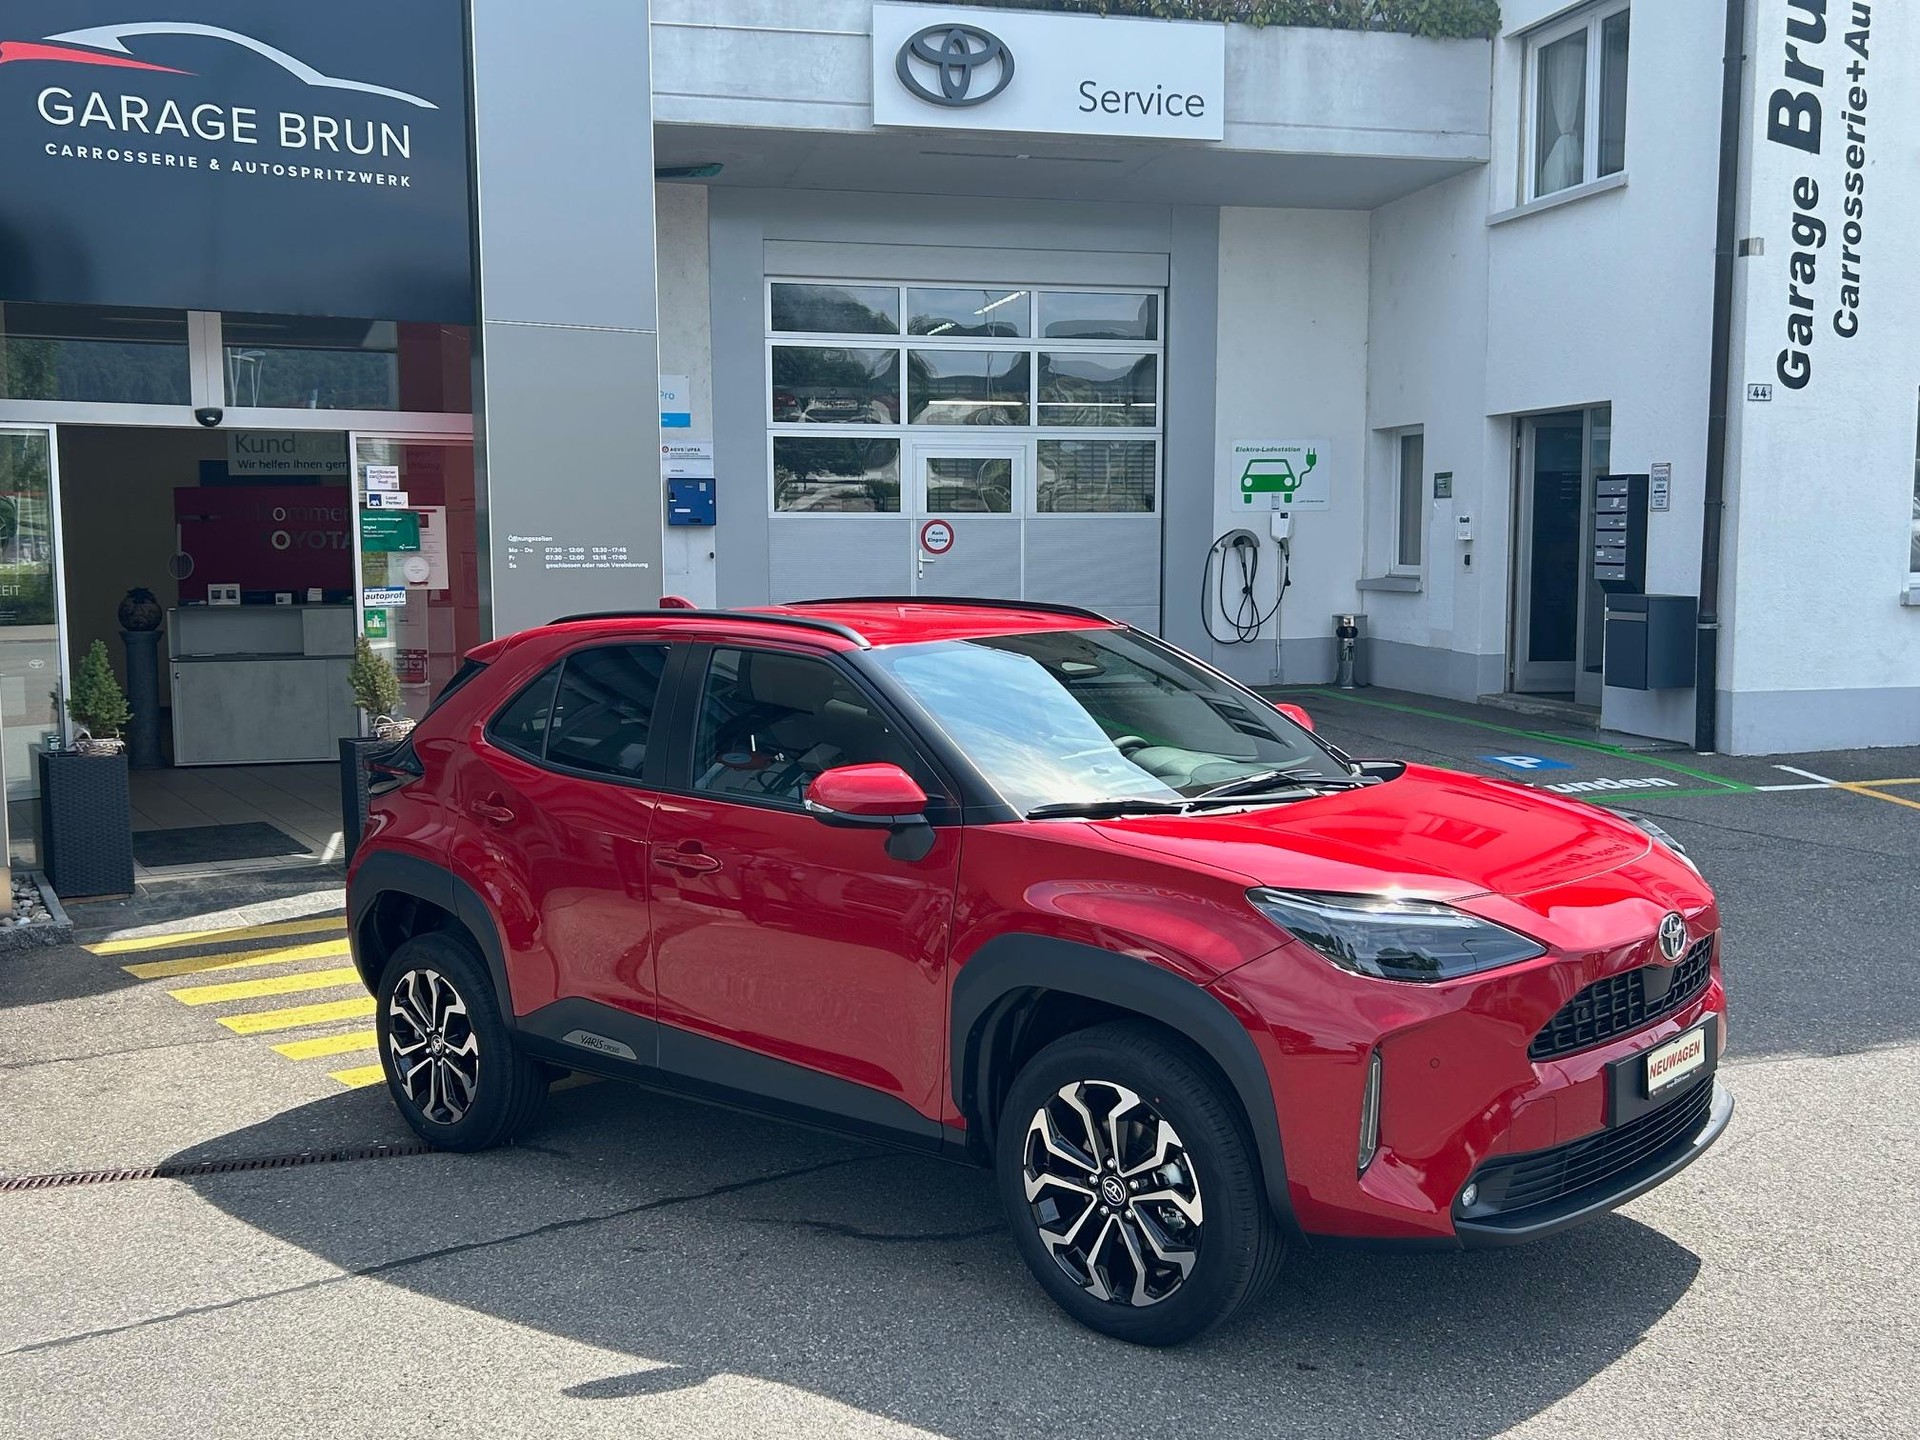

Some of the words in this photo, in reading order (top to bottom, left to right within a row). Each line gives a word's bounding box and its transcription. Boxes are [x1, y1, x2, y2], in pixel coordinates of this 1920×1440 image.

[1078, 80, 1205, 118] Service
[37, 87, 259, 145] GARAGE
[279, 111, 412, 159] BRUN
[45, 143, 199, 169] CARROSSERIE
[209, 158, 221, 171] &
[232, 160, 412, 188] AUTOSPRITZWERK
[1776, 176, 1827, 390] Garage
[1752, 386, 1768, 399] 44
[237, 460, 255, 469] Wir
[259, 459, 291, 470] helfen
[293, 459, 322, 469] Ihnen
[0, 585, 21, 596] EIT
[365, 591, 405, 601] autoprofi
[1526, 777, 1679, 793] unden
[580, 1034, 604, 1049] YARIS
[1649, 1039, 1701, 1080] NEUWAGEN
